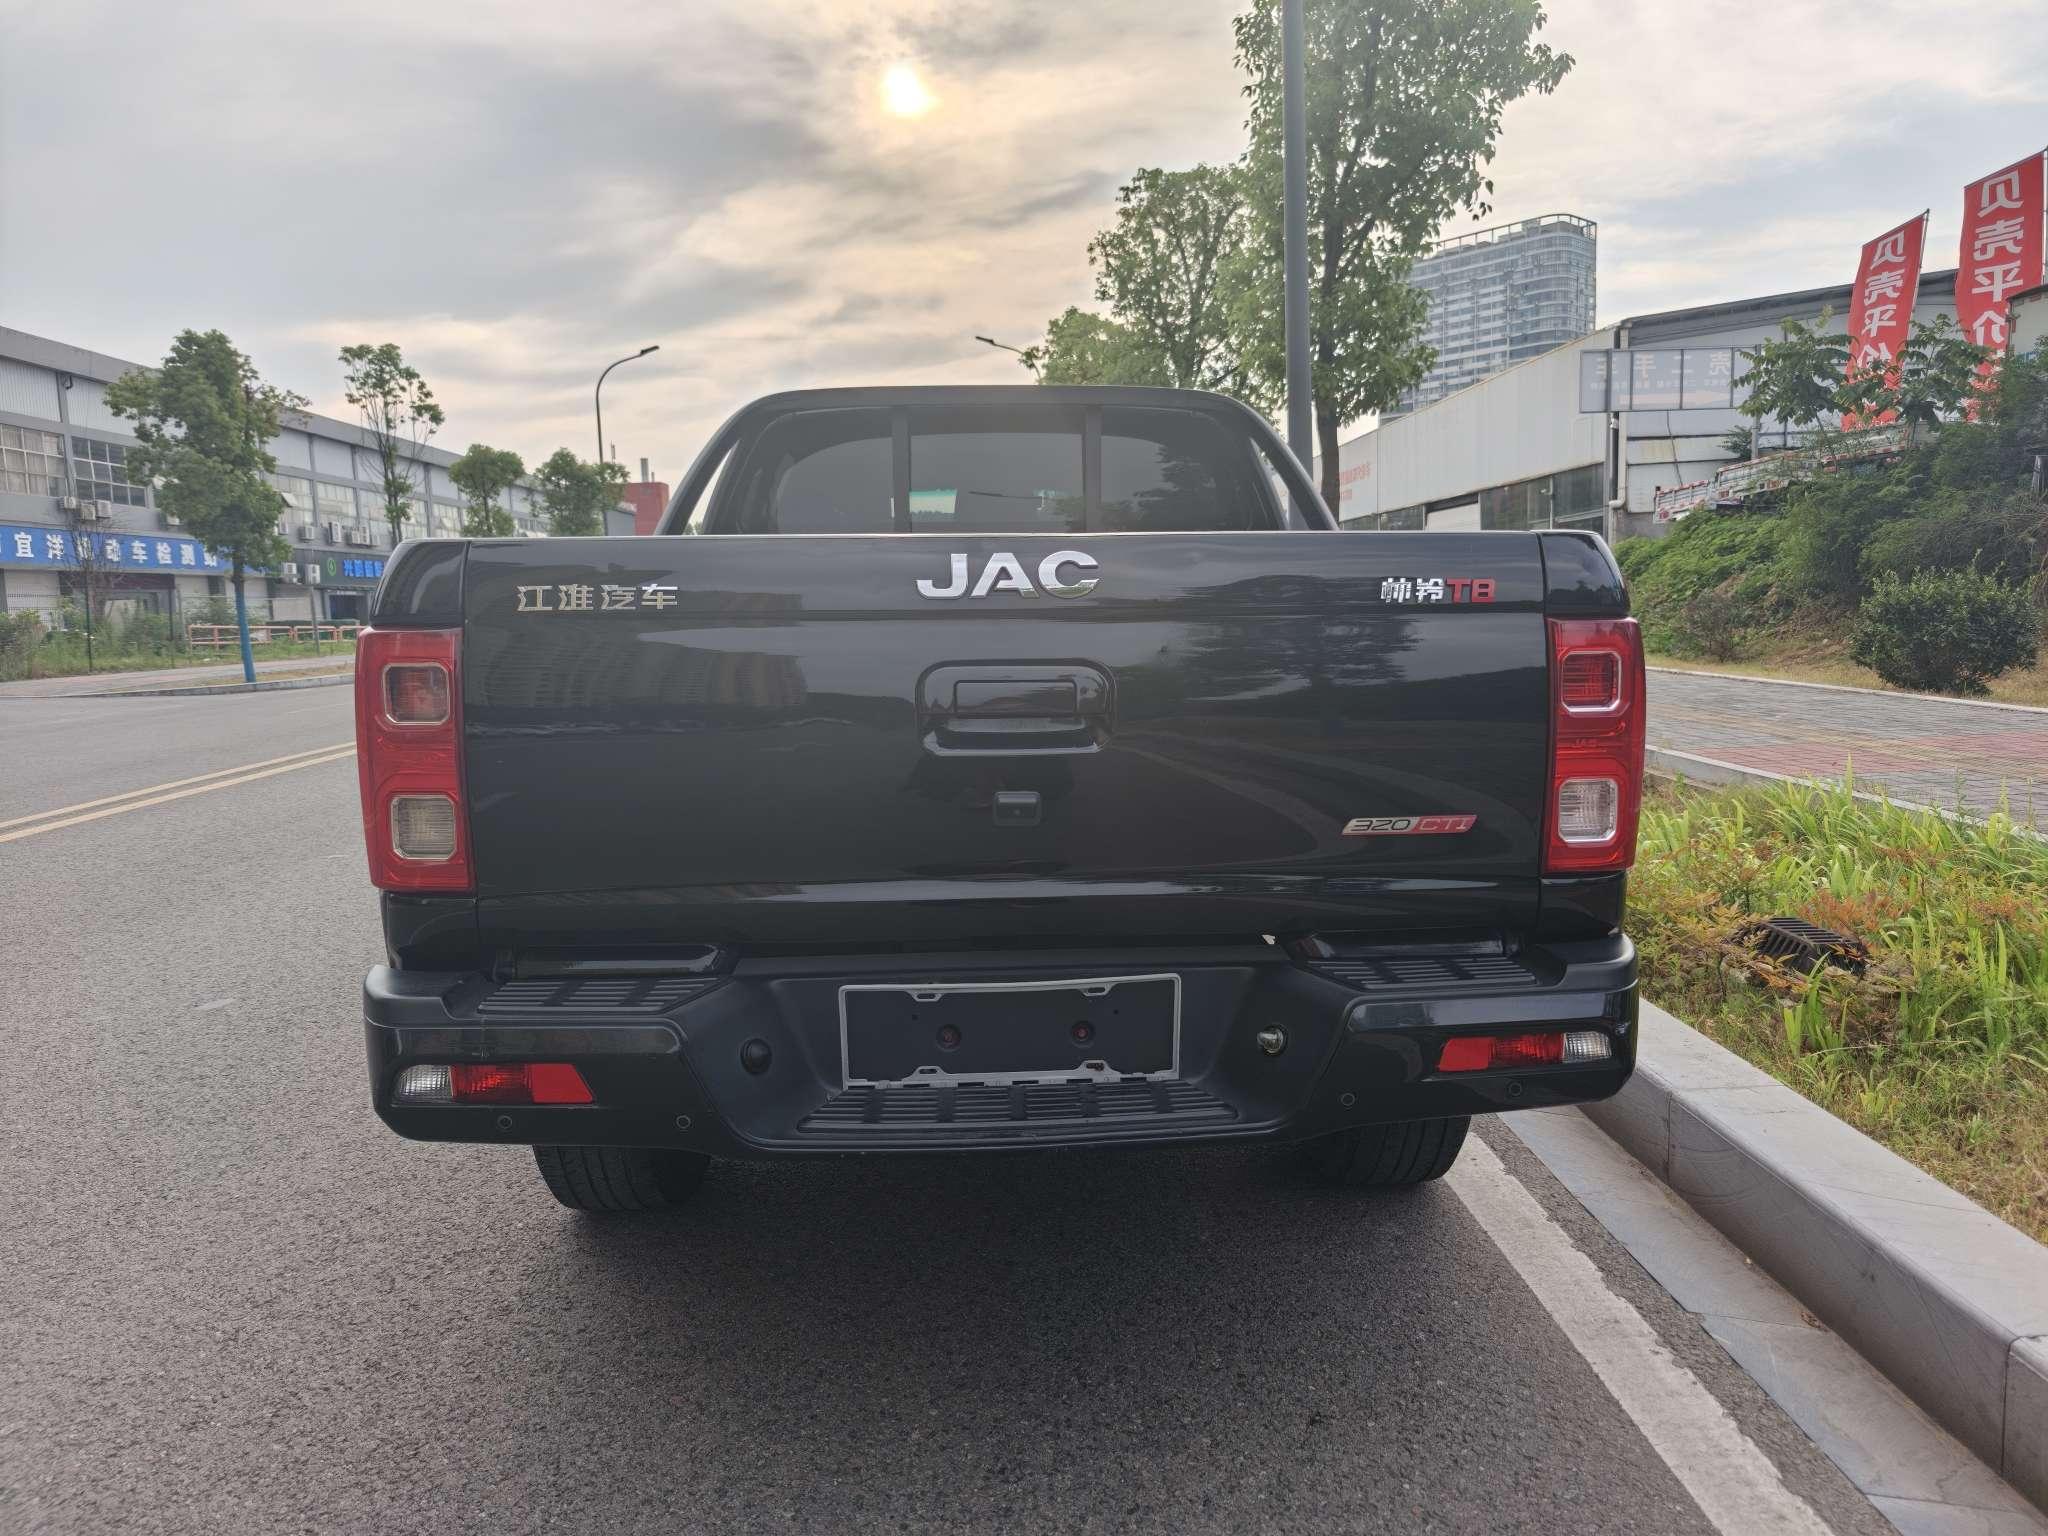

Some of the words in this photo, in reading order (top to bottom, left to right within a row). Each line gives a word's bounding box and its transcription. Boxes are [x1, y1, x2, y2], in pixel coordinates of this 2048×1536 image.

[0, 531, 218, 567] 宜洋动车检测站
[916, 550, 1100, 599] JAC
[516, 583, 679, 611] 江淮汽车
